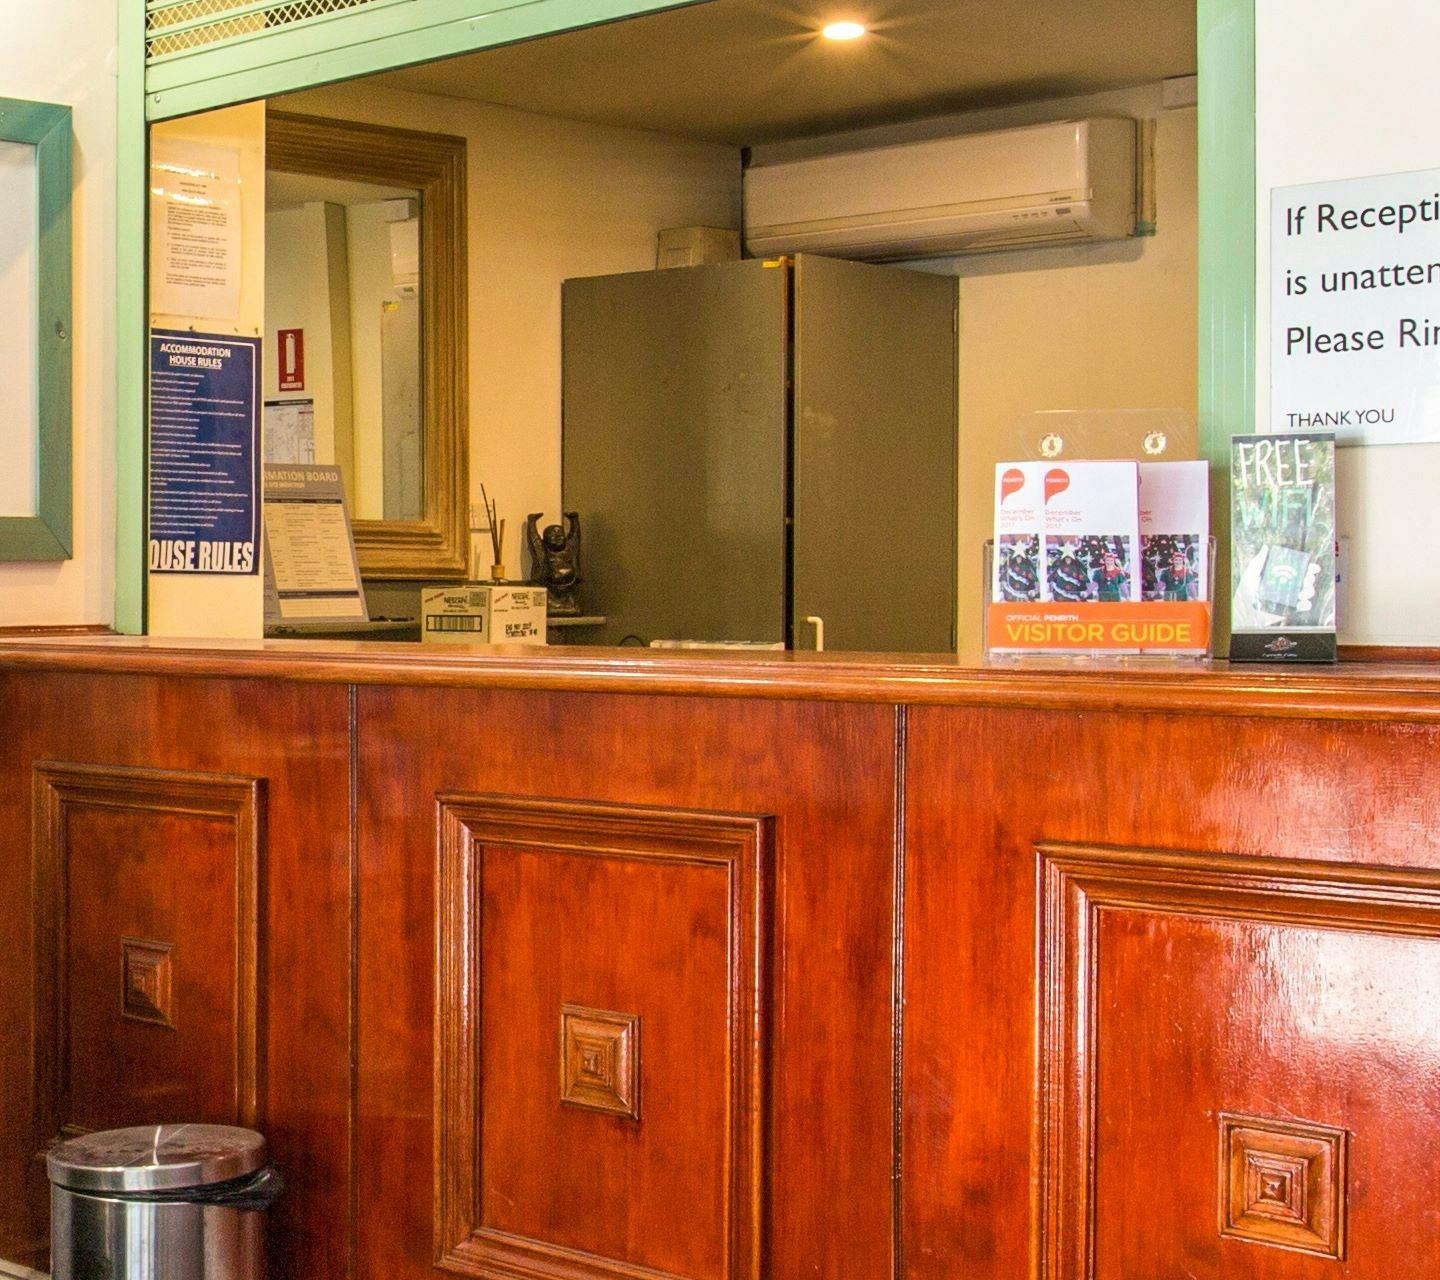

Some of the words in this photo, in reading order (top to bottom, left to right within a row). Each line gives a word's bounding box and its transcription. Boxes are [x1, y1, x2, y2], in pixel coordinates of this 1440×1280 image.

[1286, 206, 1306, 236] If
[1286, 269, 1307, 296] is
[160, 343, 232, 358] ACCOMMODATION
[1286, 325, 1385, 356] Please
[169, 355, 196, 366] HOUSE
[197, 357, 222, 368] RULES
[1286, 410, 1351, 428] THANK
[1355, 408, 1395, 425] YOU
[1238, 438, 1315, 488] FREE
[307, 472, 338, 481] BOARD
[199, 541, 253, 571] RULES
[1007, 623, 1104, 643] VISITOR
[1111, 623, 1192, 643] GUIDE
